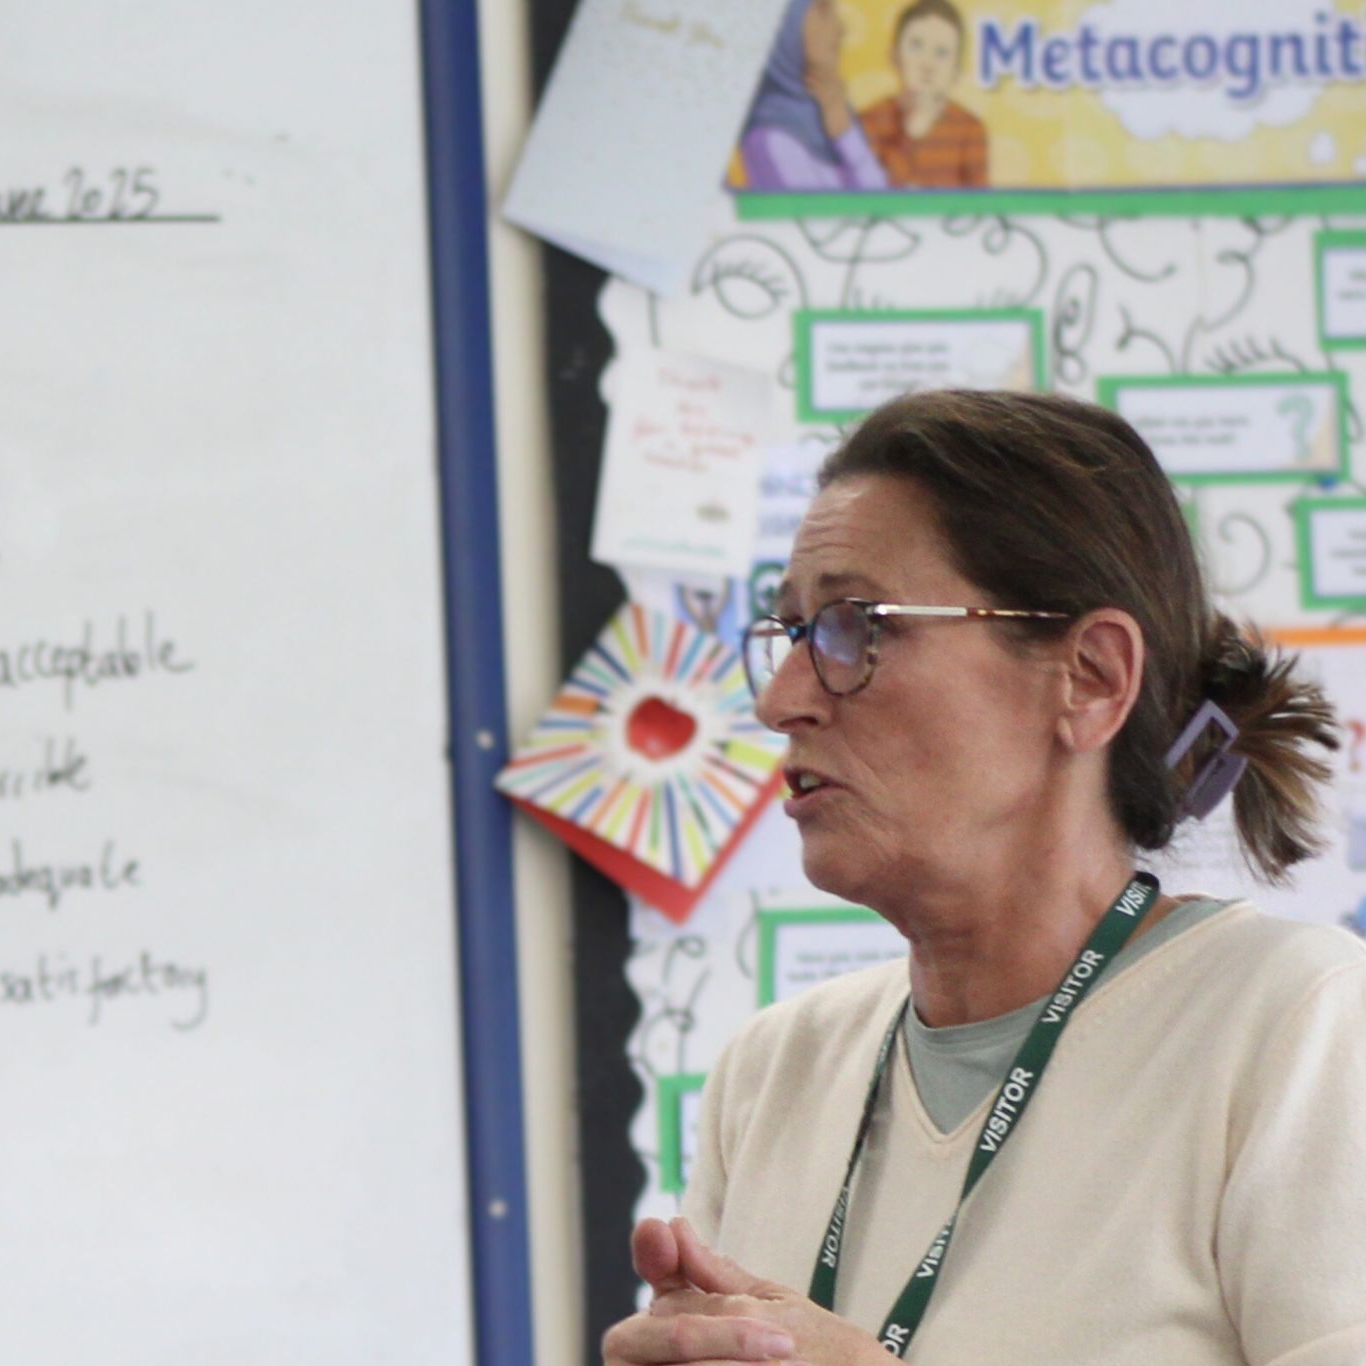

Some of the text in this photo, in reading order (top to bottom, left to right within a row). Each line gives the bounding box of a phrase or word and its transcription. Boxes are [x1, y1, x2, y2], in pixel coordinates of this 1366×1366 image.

[61, 165, 161, 222] 2025
[1039, 946, 1106, 1027] VISITOR
[978, 1065, 1035, 1156] VISITOR
